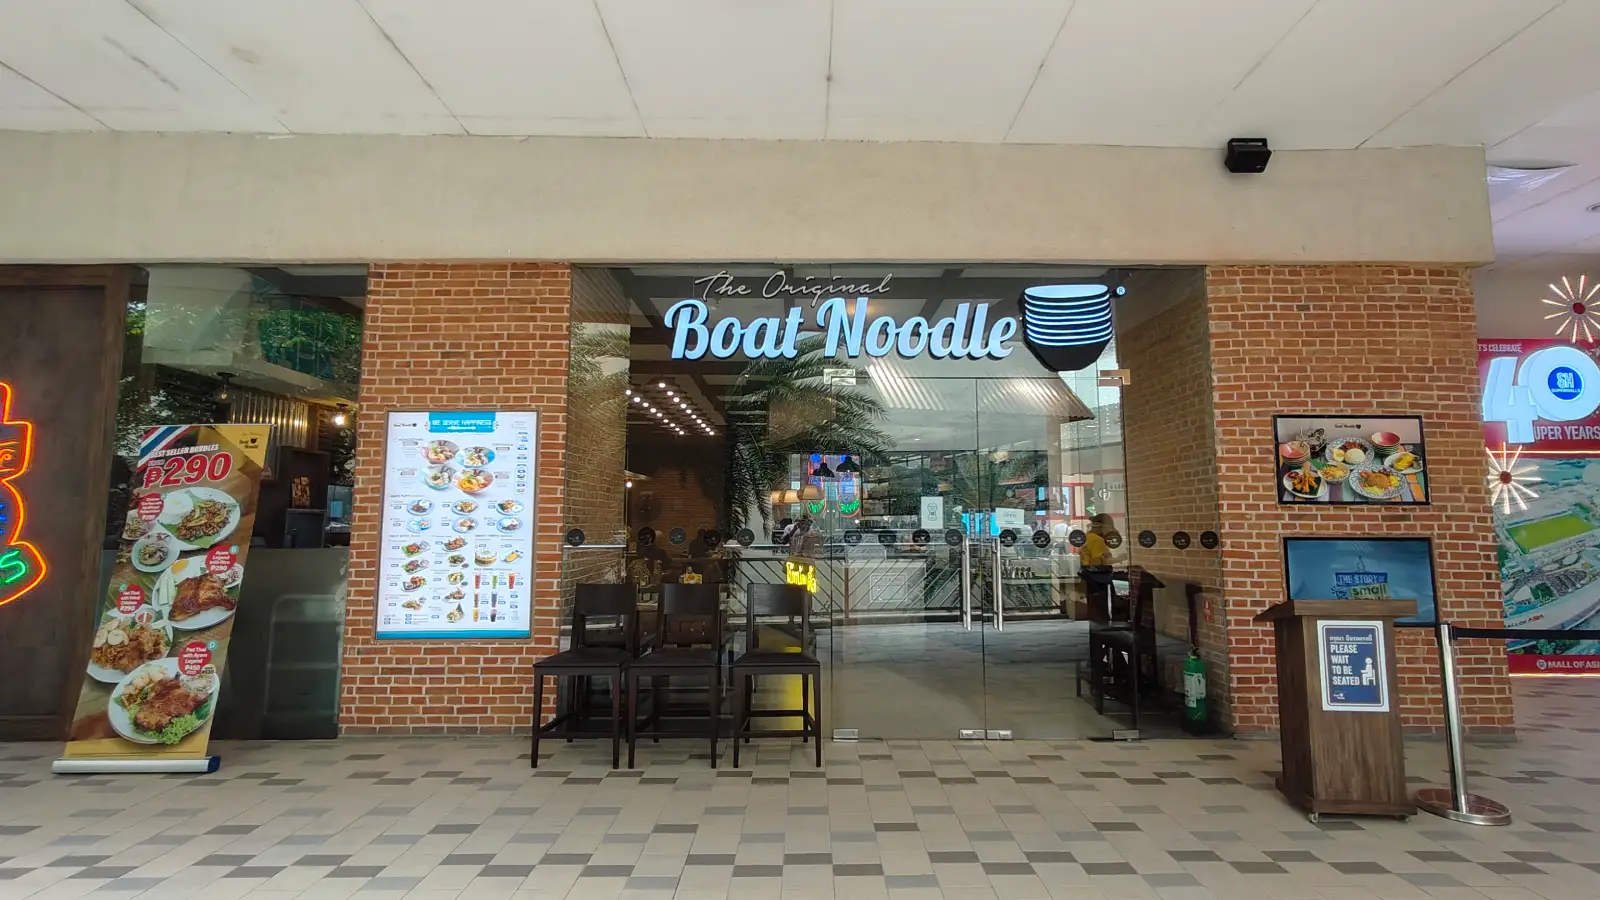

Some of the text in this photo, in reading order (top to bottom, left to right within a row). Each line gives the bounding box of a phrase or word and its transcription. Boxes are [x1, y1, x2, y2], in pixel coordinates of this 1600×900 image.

[694, 270, 893, 308] The Original
[664, 297, 1018, 360] Boat Noodle
[1477, 343, 1488, 351] T'S
[1564, 425, 1600, 440] YEARS
[150, 444, 219, 458] BEST SELLER BUNDLES
[1338, 574, 1352, 584] THE
[1354, 574, 1377, 584] STORY
[1352, 584, 1388, 595] small
[1330, 644, 1358, 653] PLEASE
[1331, 655, 1350, 664] WAIT
[1547, 661, 1573, 669] MALL
[1573, 661, 1584, 669] OF
[1332, 666, 1353, 675] TO BE
[1332, 676, 1360, 686] SEATED
